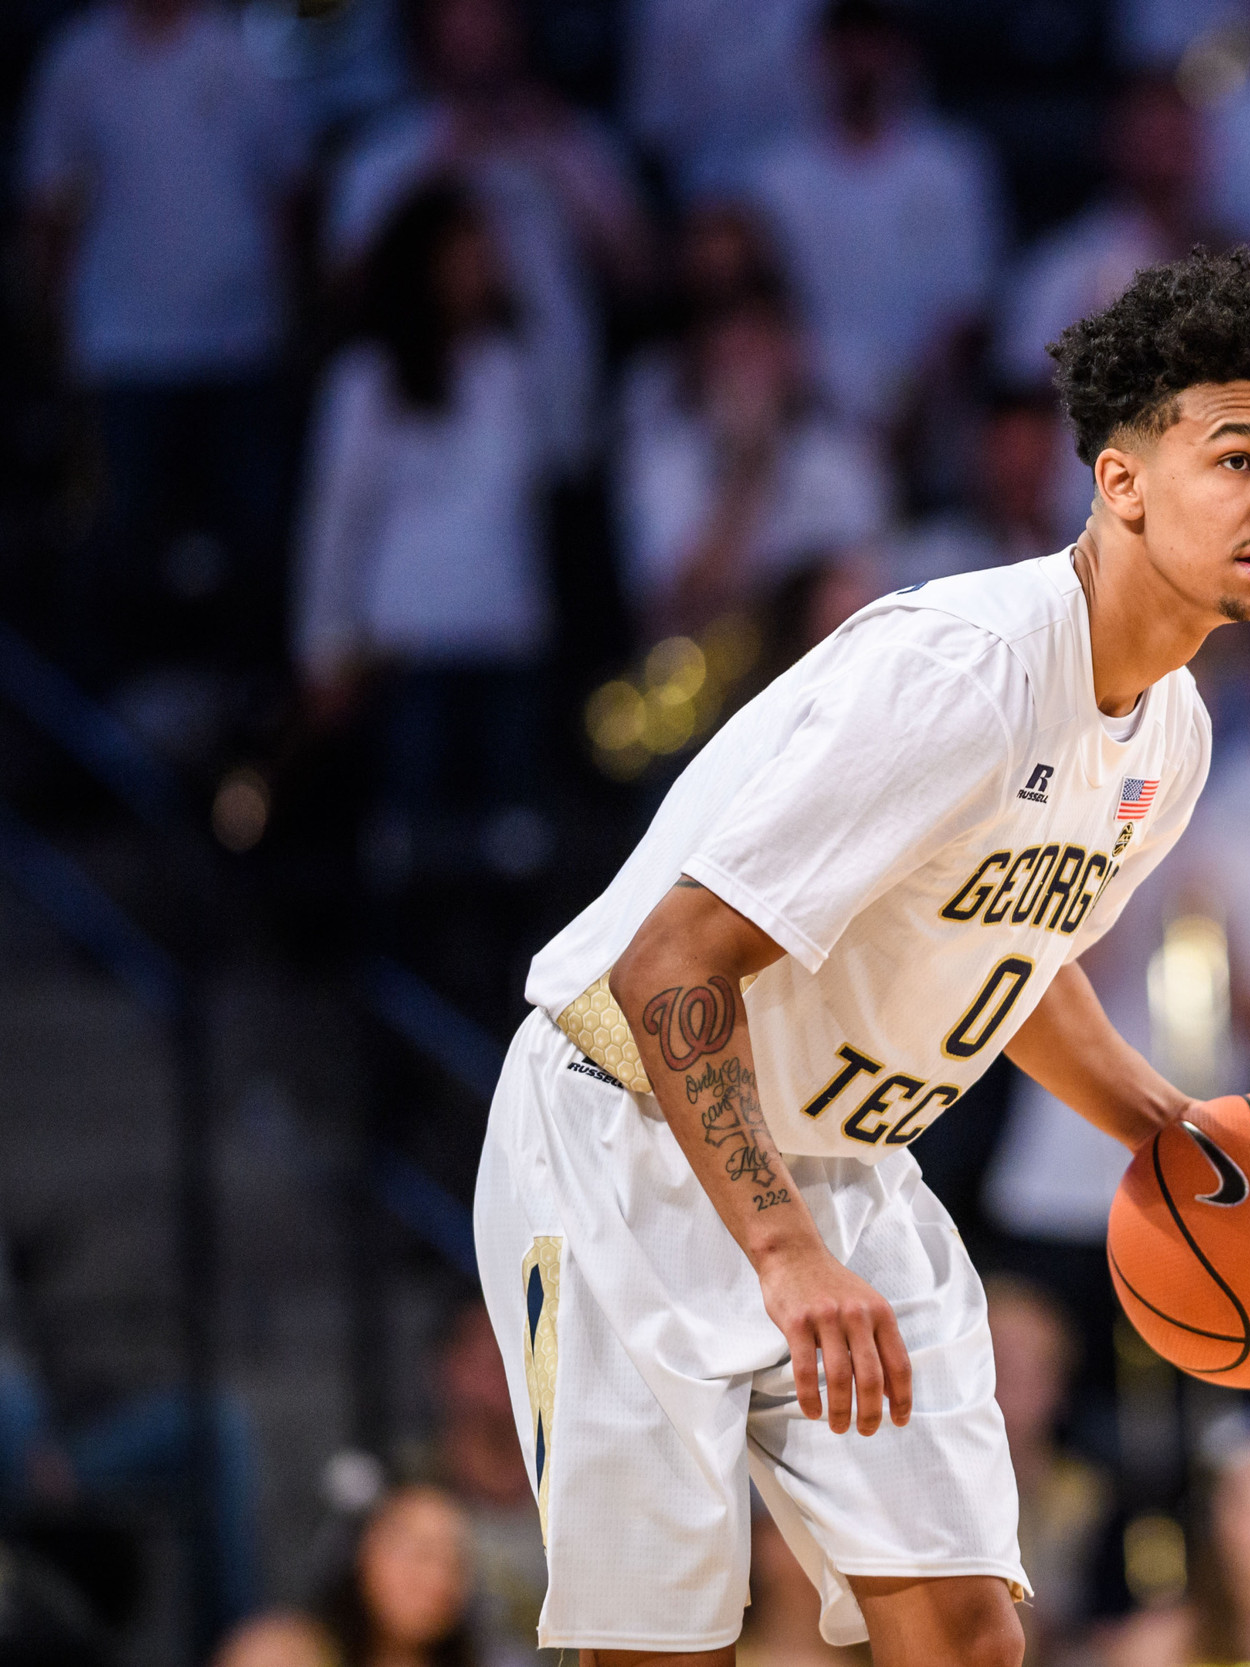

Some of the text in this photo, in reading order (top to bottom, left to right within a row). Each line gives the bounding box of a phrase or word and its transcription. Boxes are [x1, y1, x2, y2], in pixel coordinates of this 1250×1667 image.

[1016, 789, 1048, 804] RUSSELL
[1025, 763, 1054, 792] R
[938, 841, 1120, 936] GEORG
[940, 953, 1035, 1062] 0
[800, 1042, 962, 1146] TEC
